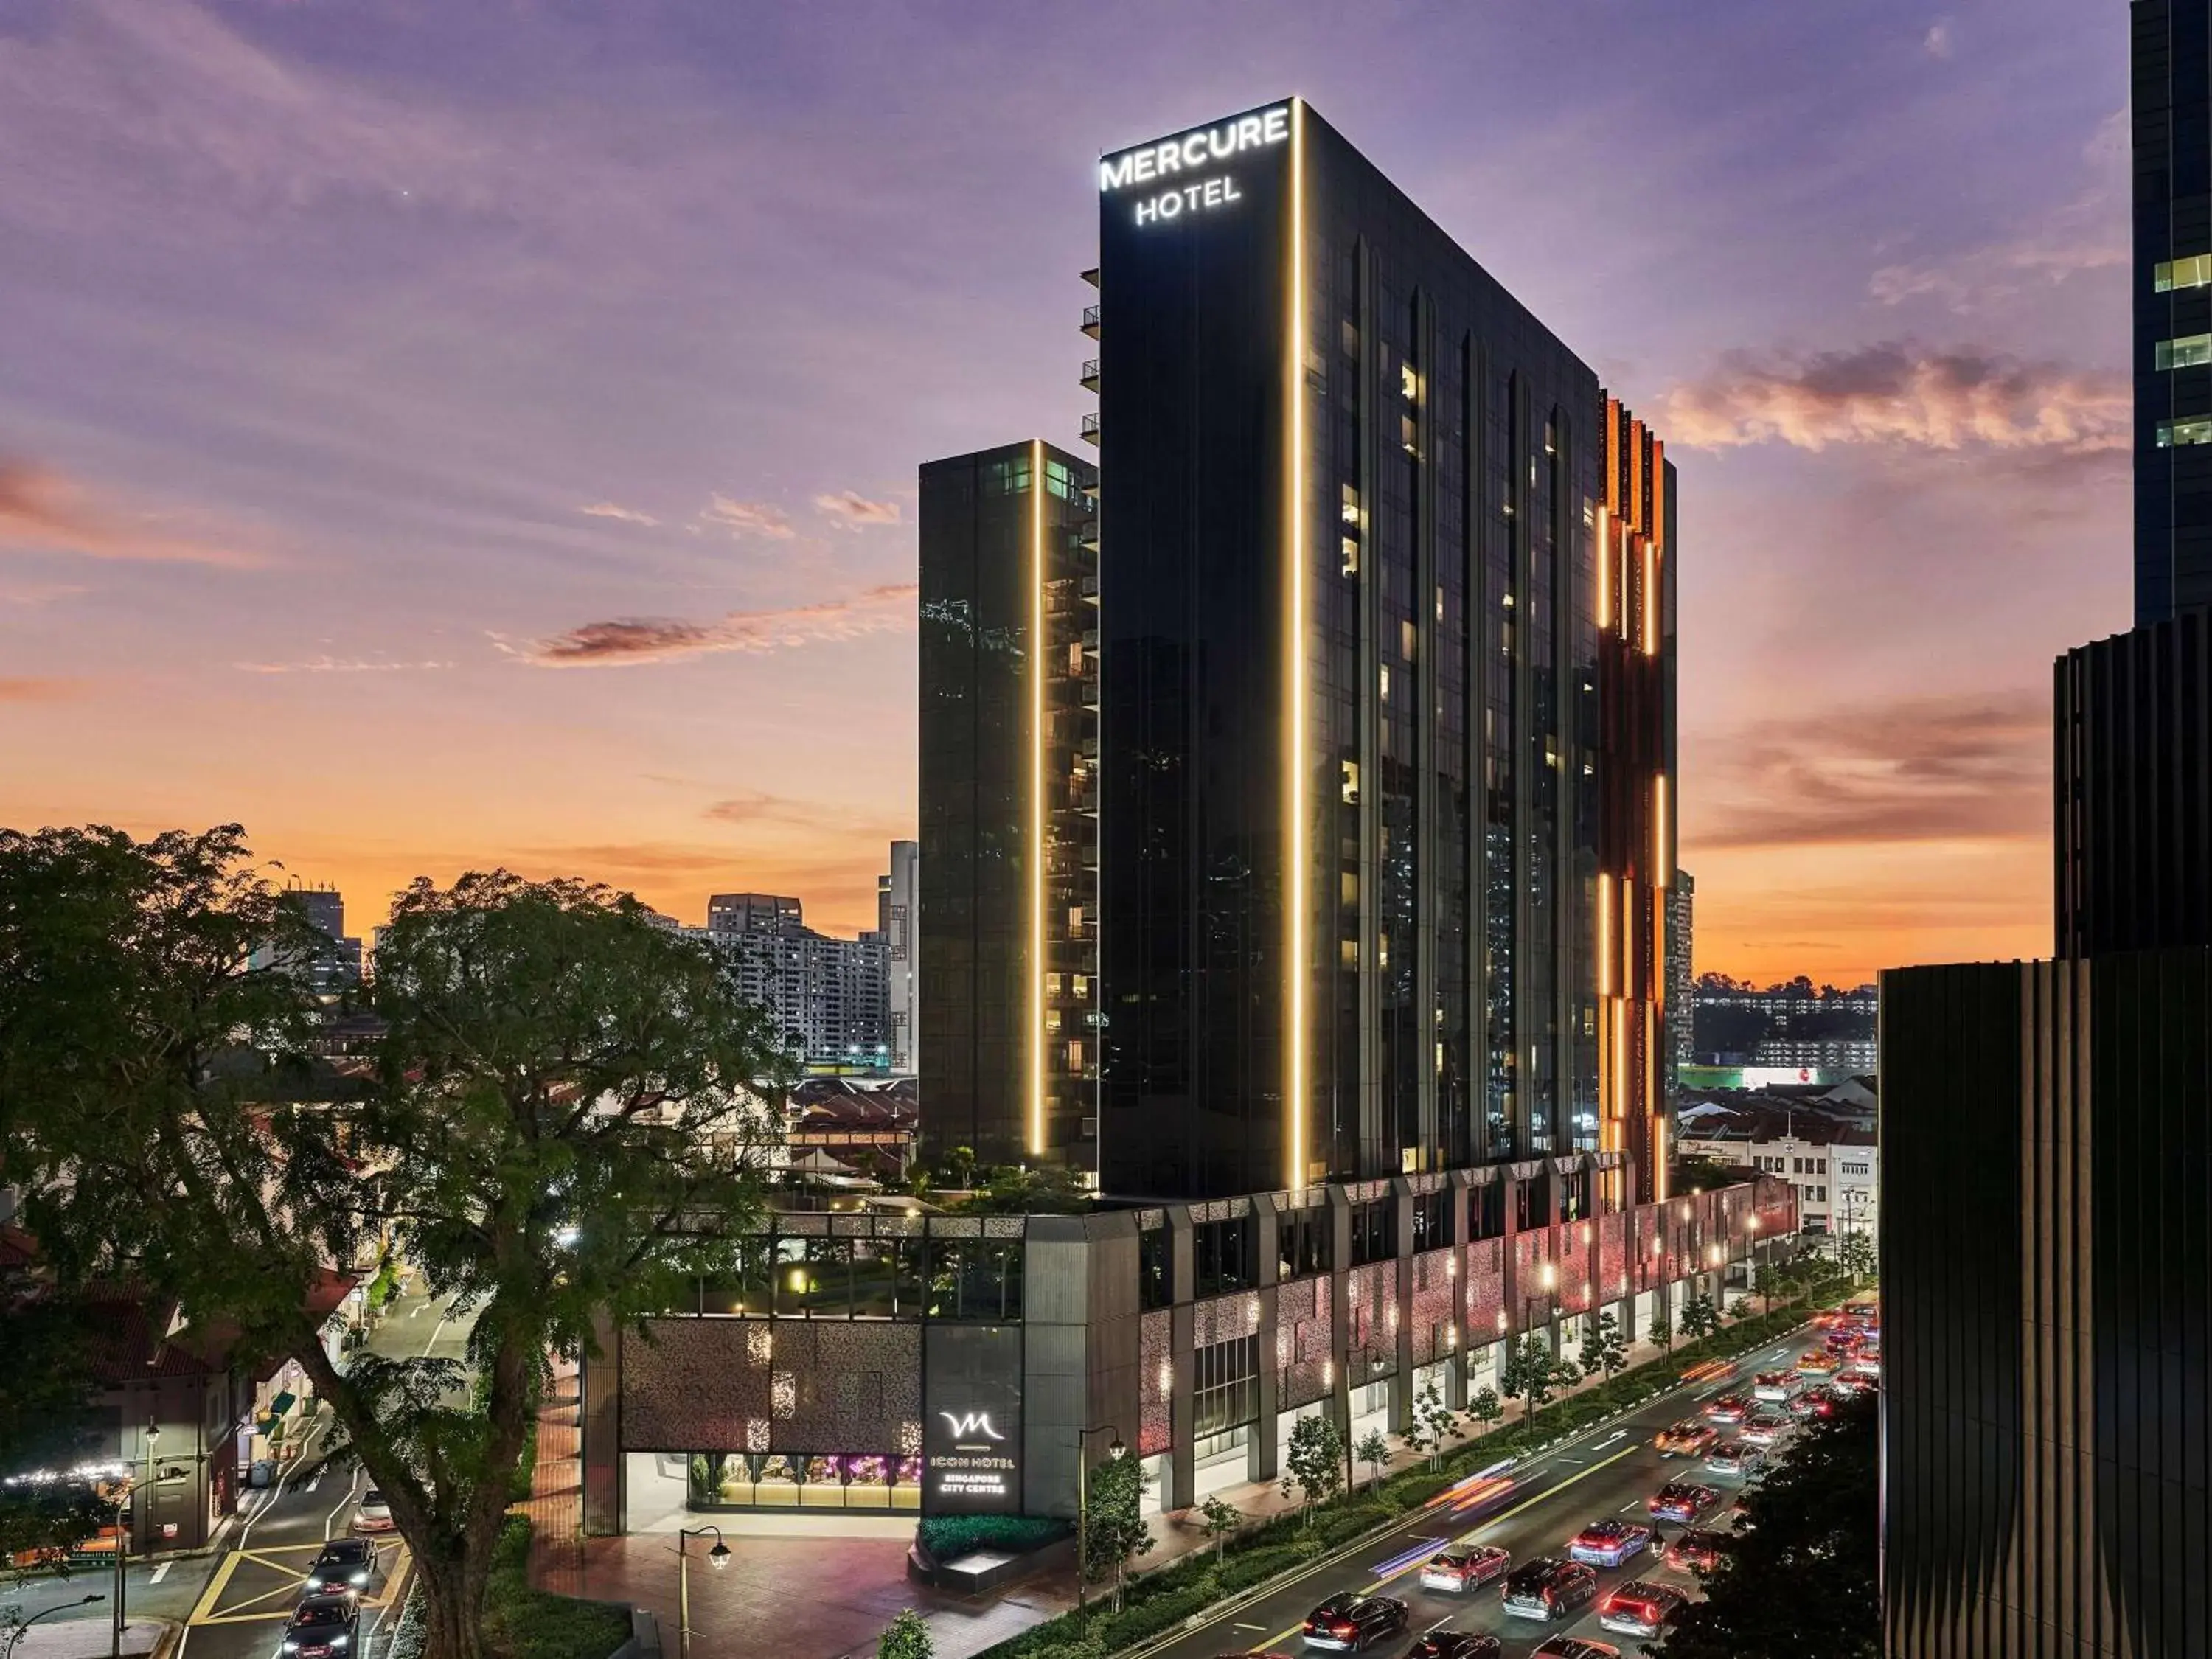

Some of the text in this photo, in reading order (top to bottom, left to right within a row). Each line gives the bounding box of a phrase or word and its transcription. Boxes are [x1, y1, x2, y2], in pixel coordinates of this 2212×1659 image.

[1100, 108, 1289, 192] MERCURE
[1136, 176, 1241, 226] HOTEL
[930, 1456, 1015, 1470] ICON HOTEL
[945, 1474, 1001, 1484] SINGAPORE
[940, 1484, 1005, 1494] CITY CENTRE
